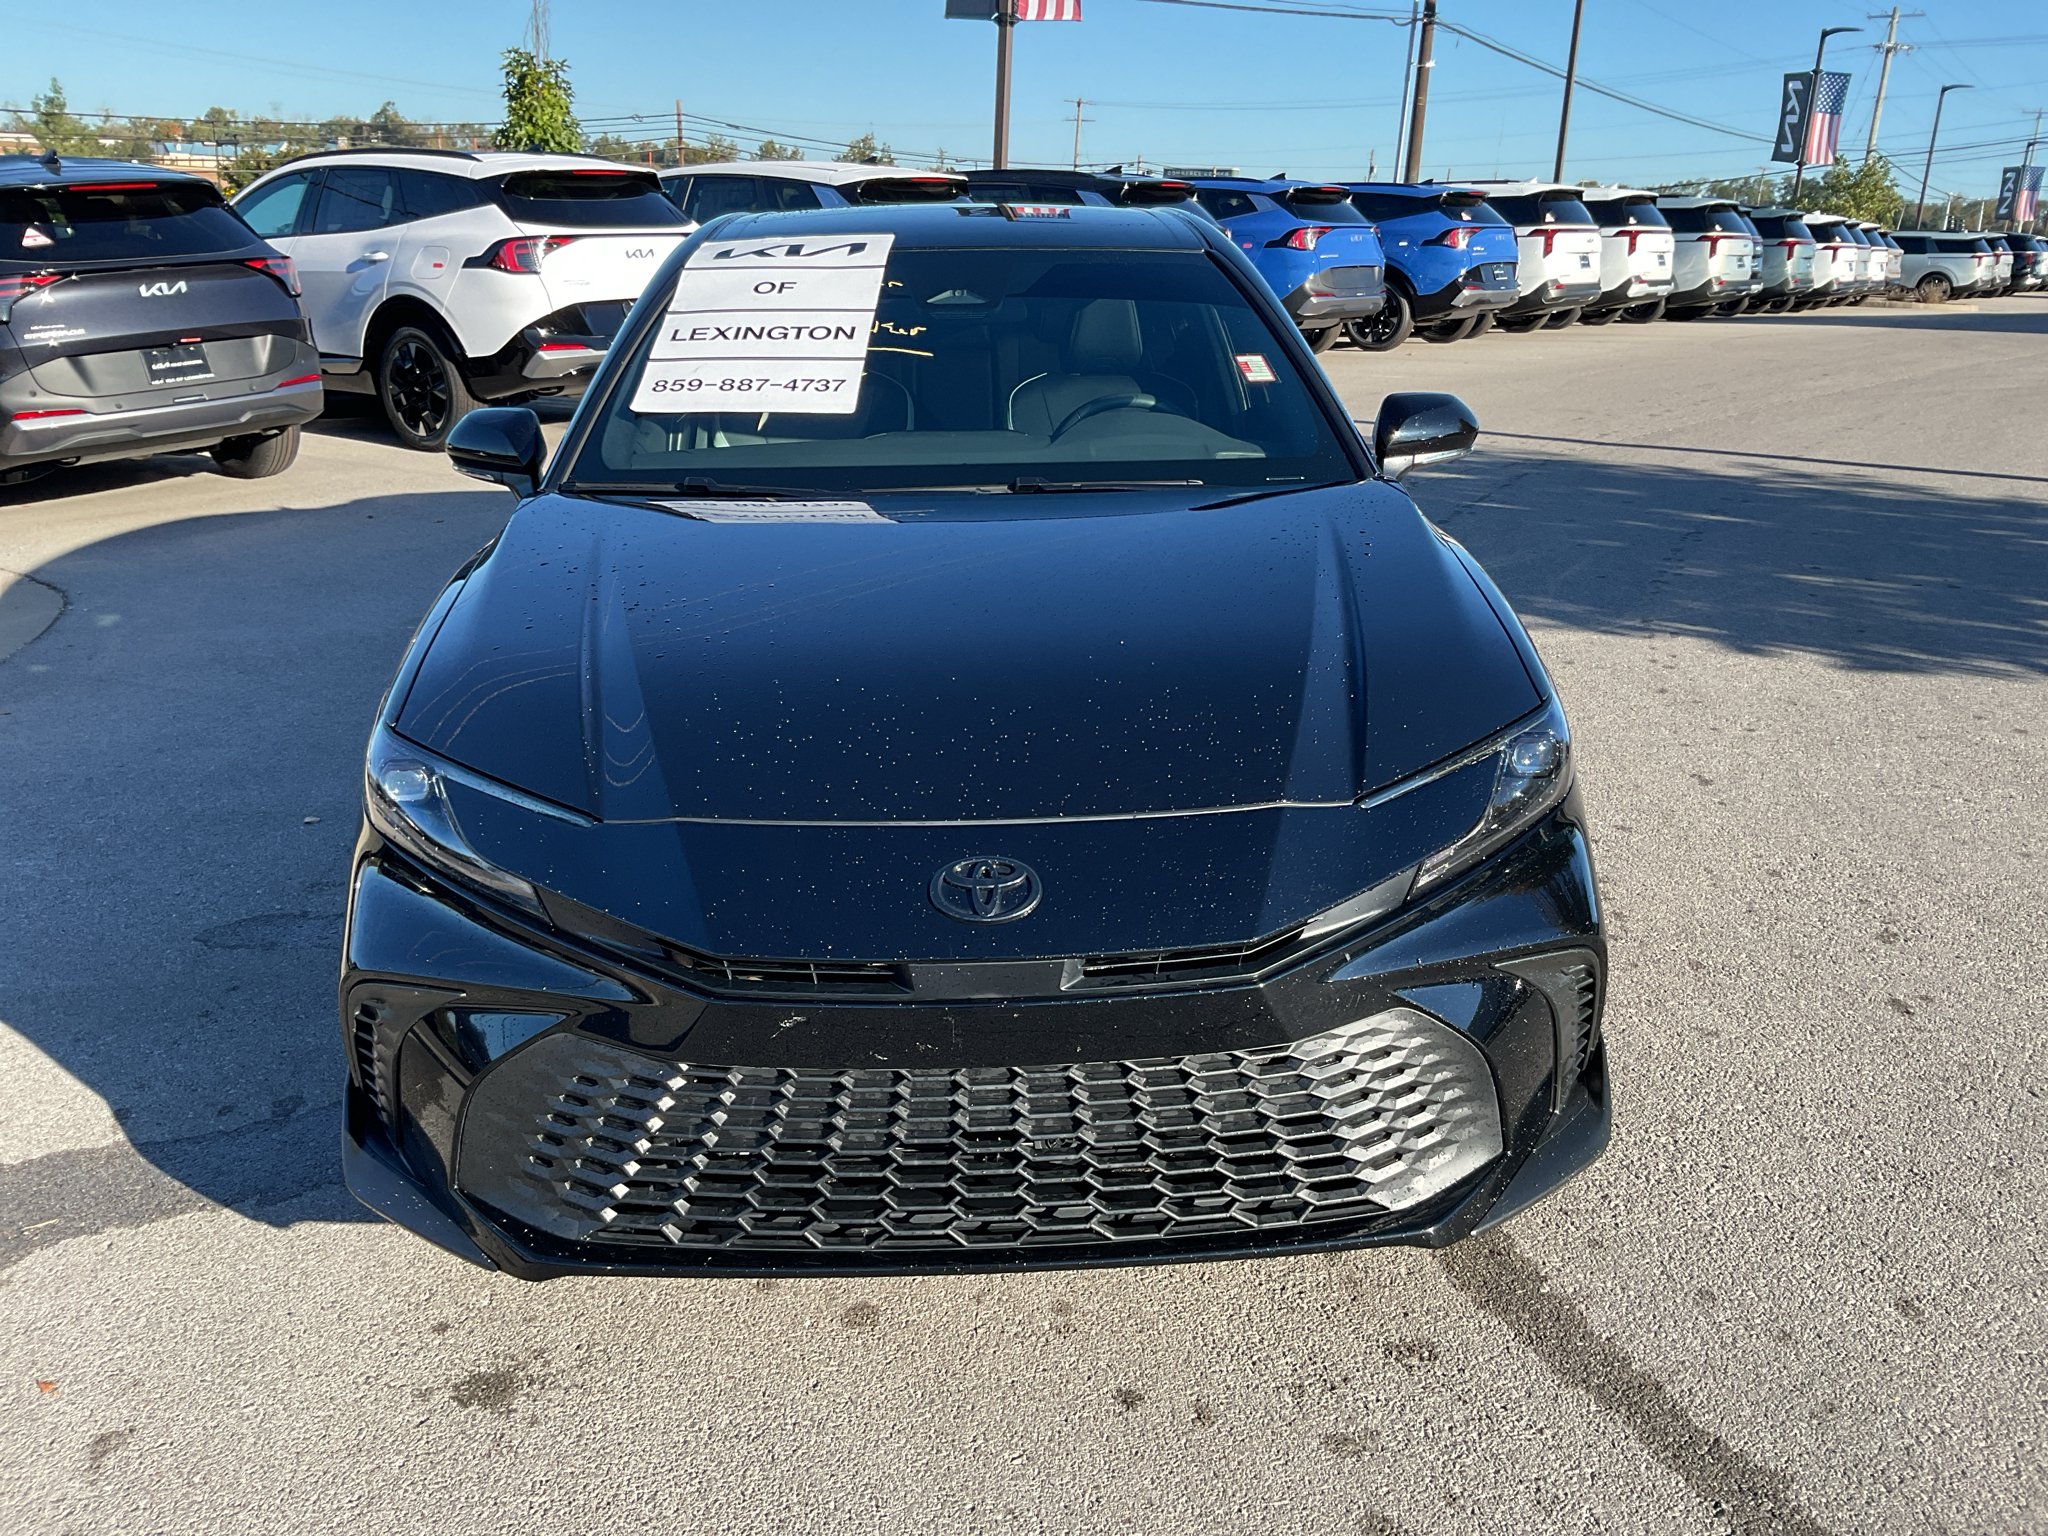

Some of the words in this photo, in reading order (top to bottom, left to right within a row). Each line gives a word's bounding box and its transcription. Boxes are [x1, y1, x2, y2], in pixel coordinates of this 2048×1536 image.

[625, 248, 655, 259] KIA
[712, 242, 869, 260] KIA
[139, 280, 188, 297] KIA
[752, 281, 797, 295] OF
[669, 325, 857, 343] LEXINGTON
[651, 378, 847, 393] 859-887-4737
